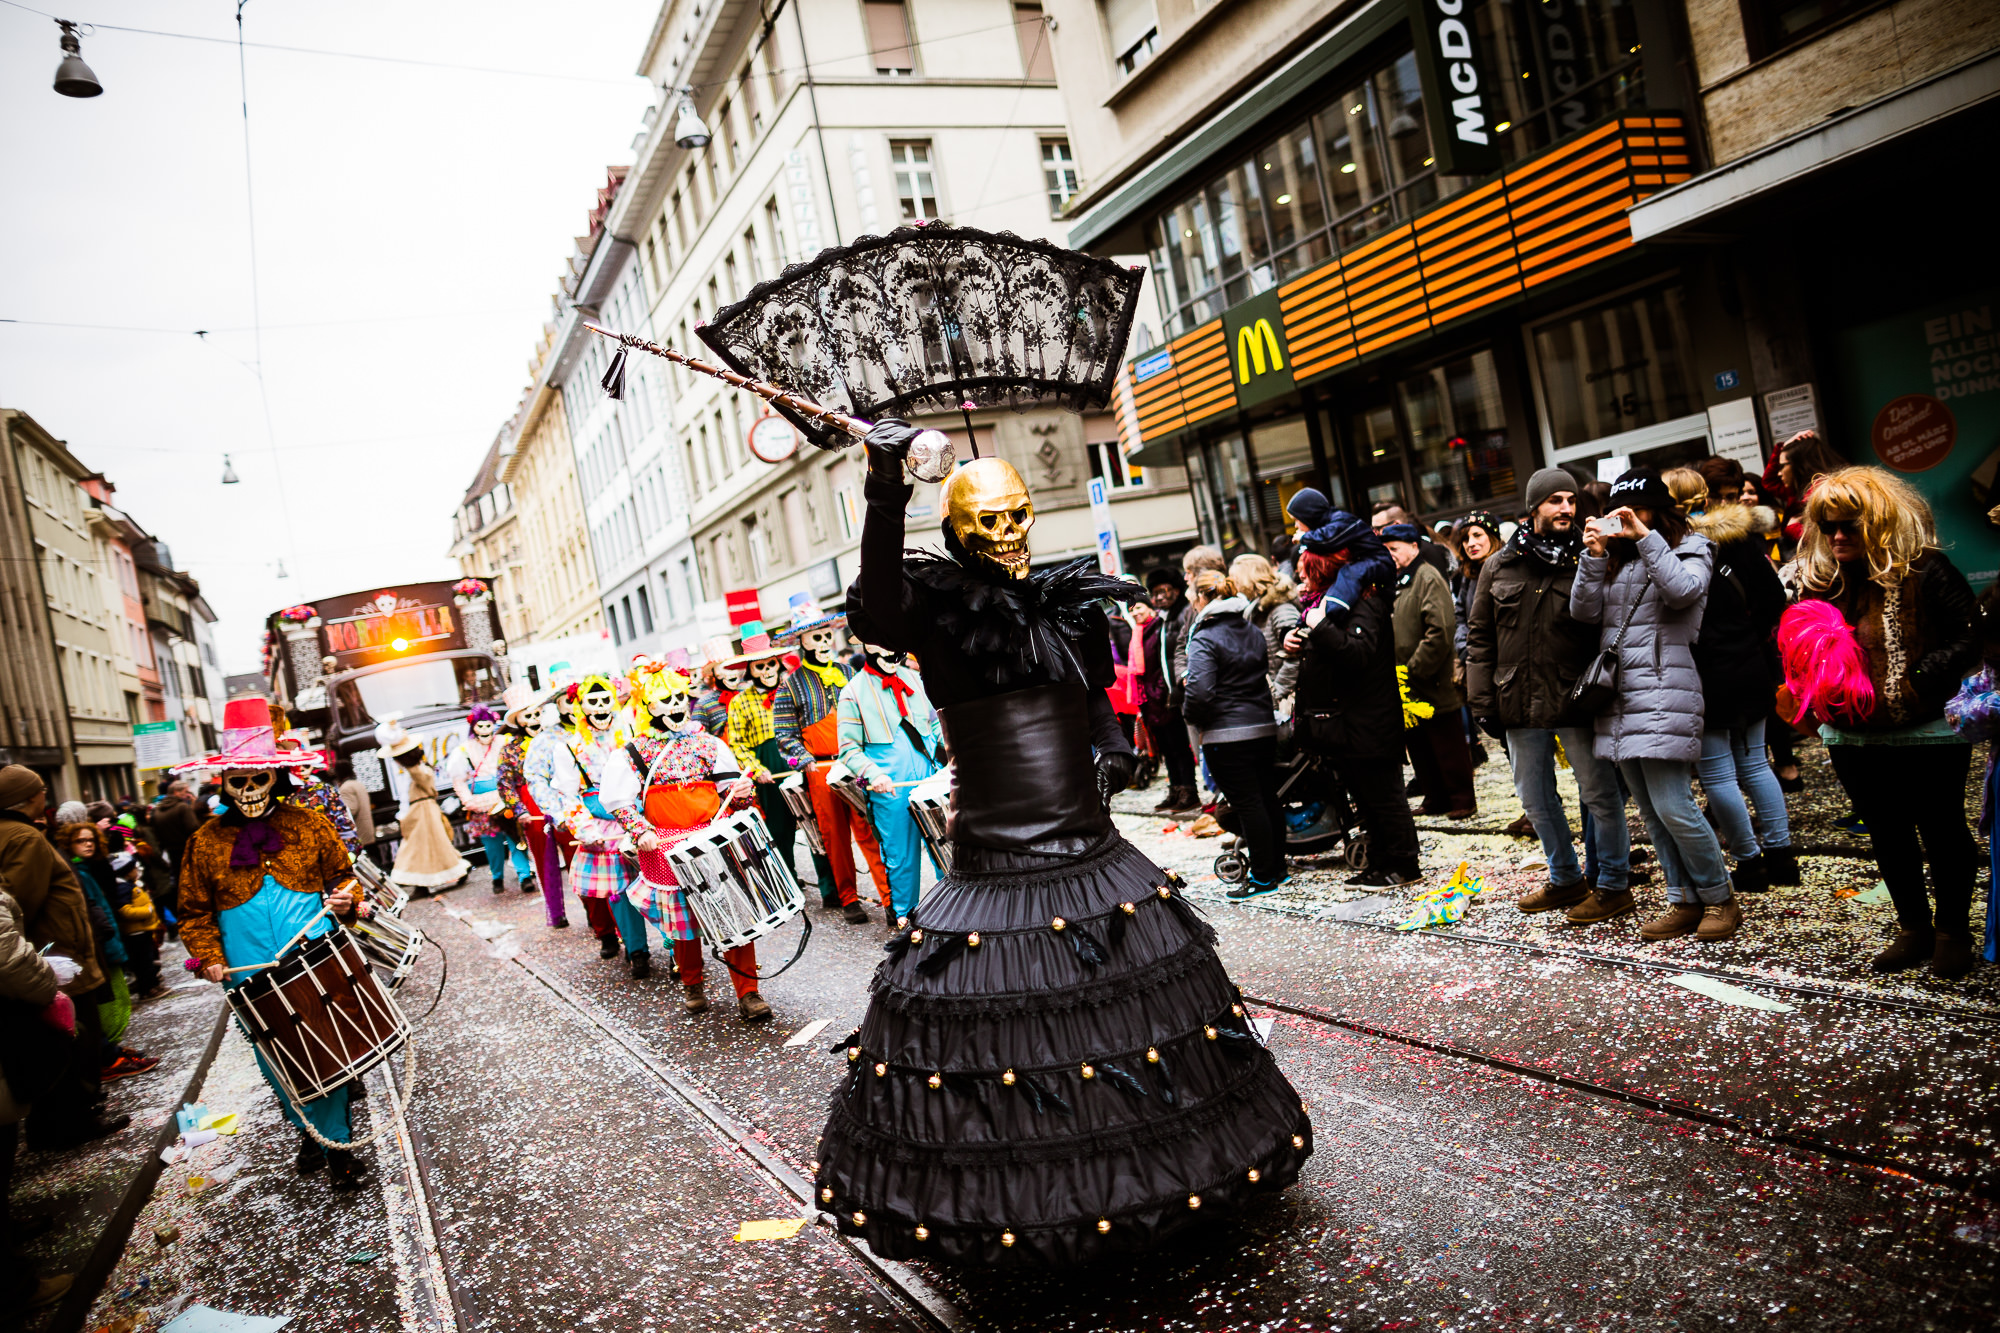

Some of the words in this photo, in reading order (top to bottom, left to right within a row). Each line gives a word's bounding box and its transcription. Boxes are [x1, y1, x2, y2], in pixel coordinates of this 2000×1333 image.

[1925, 306, 1992, 344] EIN
[1237, 318, 1284, 385] M
[1720, 374, 1734, 387] 15
[1935, 374, 2000, 401] DUNK
[1611, 393, 1638, 418] 15
[1917, 423, 1949, 443] MÄRZ
[1924, 435, 1949, 451] UHR
